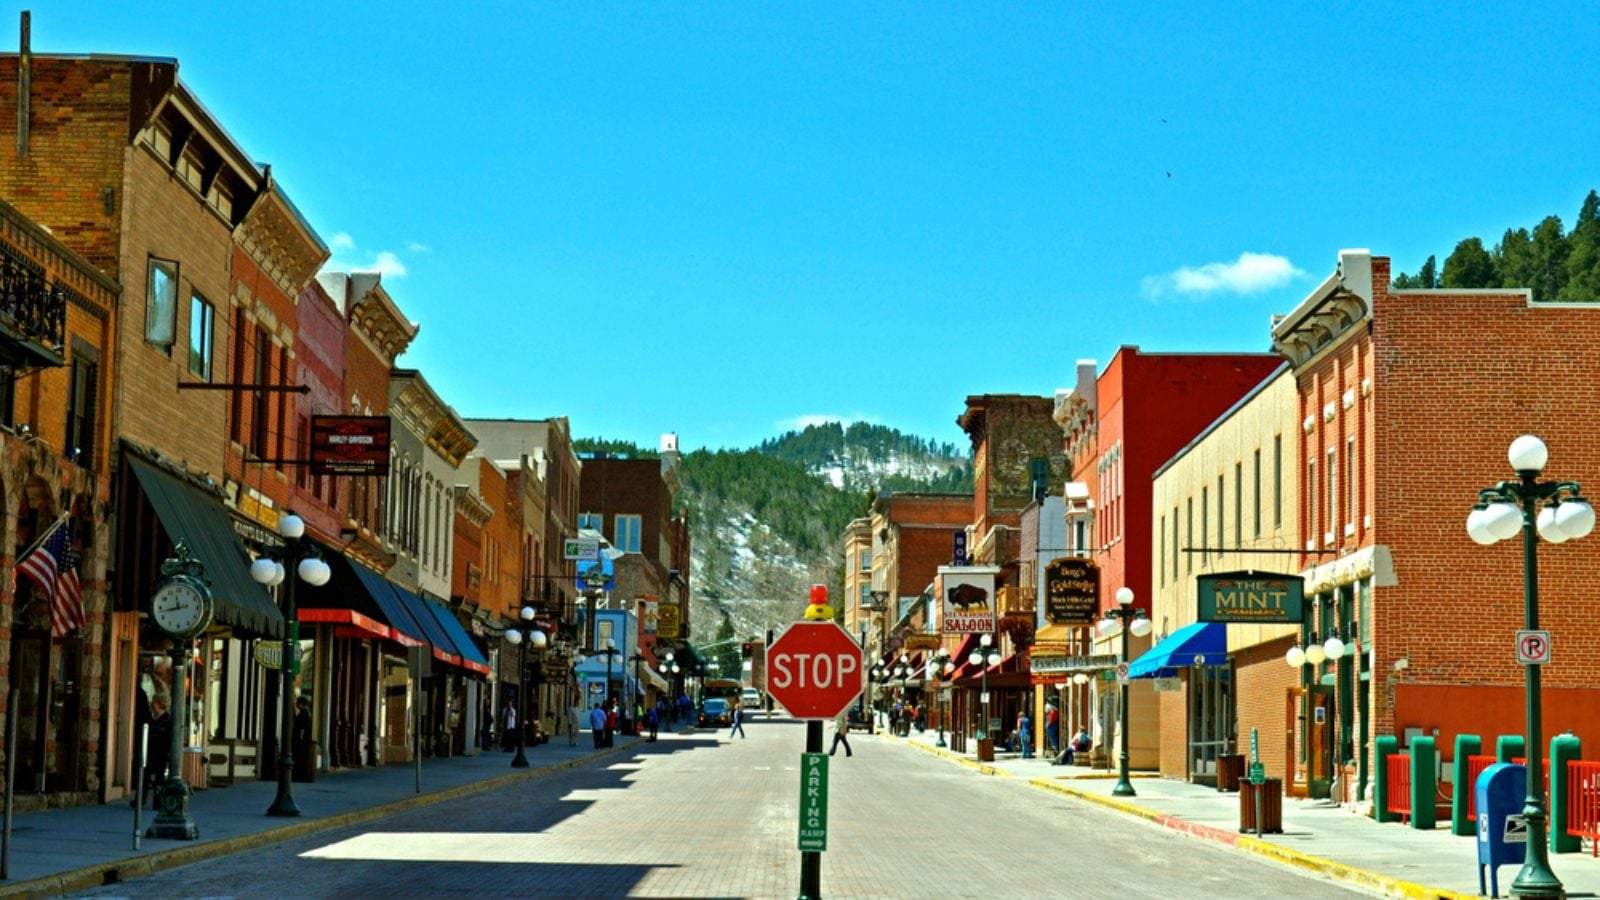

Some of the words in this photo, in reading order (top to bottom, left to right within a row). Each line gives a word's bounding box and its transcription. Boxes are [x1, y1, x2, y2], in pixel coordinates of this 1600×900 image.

[1234, 581, 1266, 590] THE
[1215, 591, 1287, 609] MINT
[944, 618, 993, 631] SALOON
[773, 653, 857, 688] STOP
[807, 756, 820, 828] PARKING
[801, 829, 825, 837] RAMP
